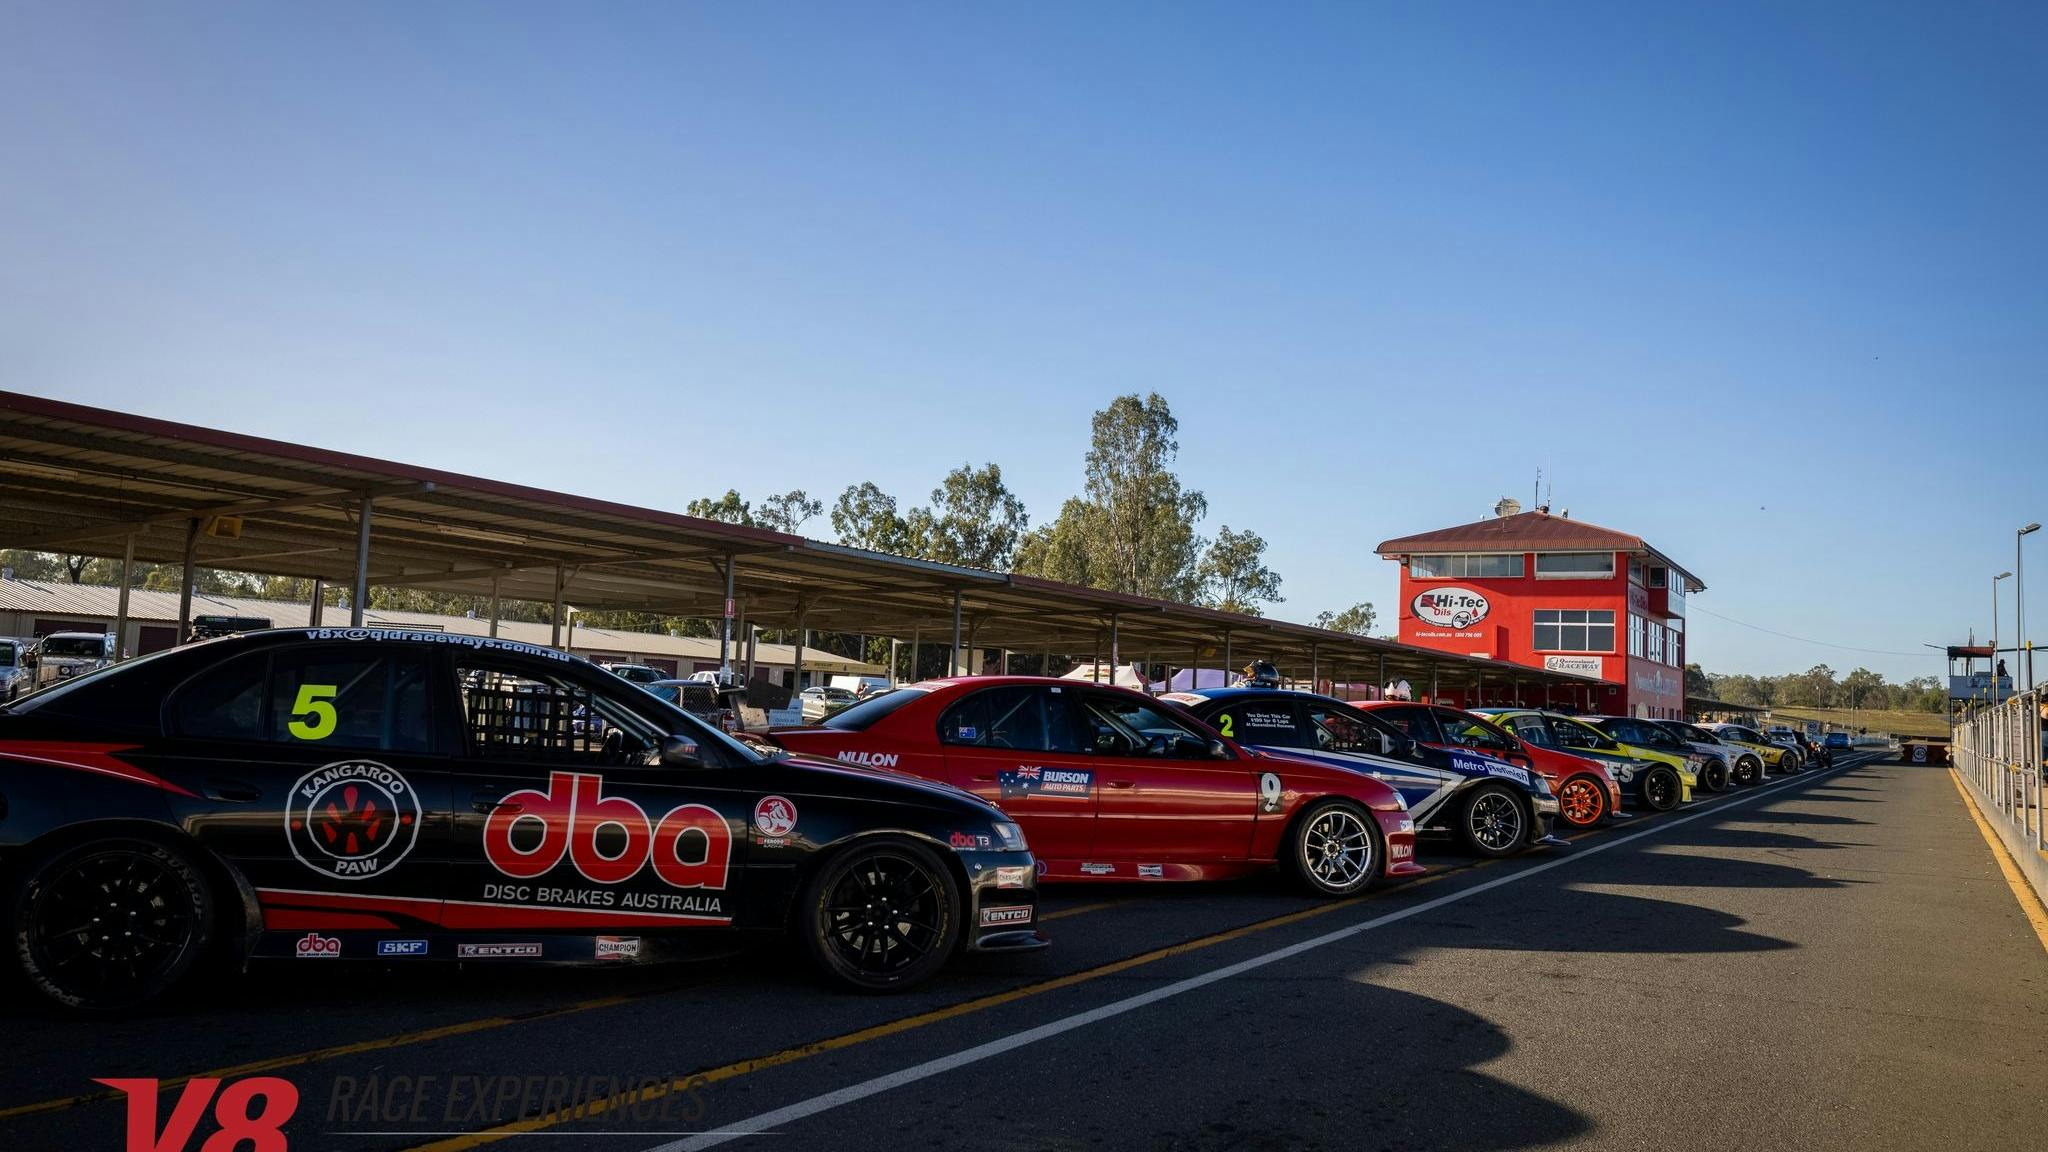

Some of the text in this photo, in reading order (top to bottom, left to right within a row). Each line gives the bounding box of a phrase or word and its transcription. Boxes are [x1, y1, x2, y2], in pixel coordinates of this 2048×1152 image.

[1435, 595, 1484, 608] Hi-Tec
[1433, 608, 1452, 616] Oils
[306, 629, 570, 662] v8x@qldraceways.com.au
[287, 684, 338, 740] 5
[1220, 714, 1234, 737] 2
[837, 750, 899, 767] NULON
[1453, 758, 1486, 771] Metro
[1042, 771, 1090, 784] BURSON
[1487, 764, 1528, 782] Refinish
[301, 765, 405, 799] KANGAROO
[1044, 783, 1085, 792] AUTO PARTS
[1261, 772, 1281, 812] 9
[483, 770, 732, 890] dba
[950, 831, 977, 847] dba
[976, 836, 989, 846] T3
[1391, 844, 1413, 858] NULON
[335, 858, 378, 874] PAW
[483, 884, 722, 912] DISC BRAKES AUSTRALIA
[983, 910, 1029, 922] RENTCO
[296, 933, 341, 953] dba
[383, 942, 423, 952] SKF
[464, 945, 537, 955] RENTCO
[599, 943, 637, 952] CHAMPION
